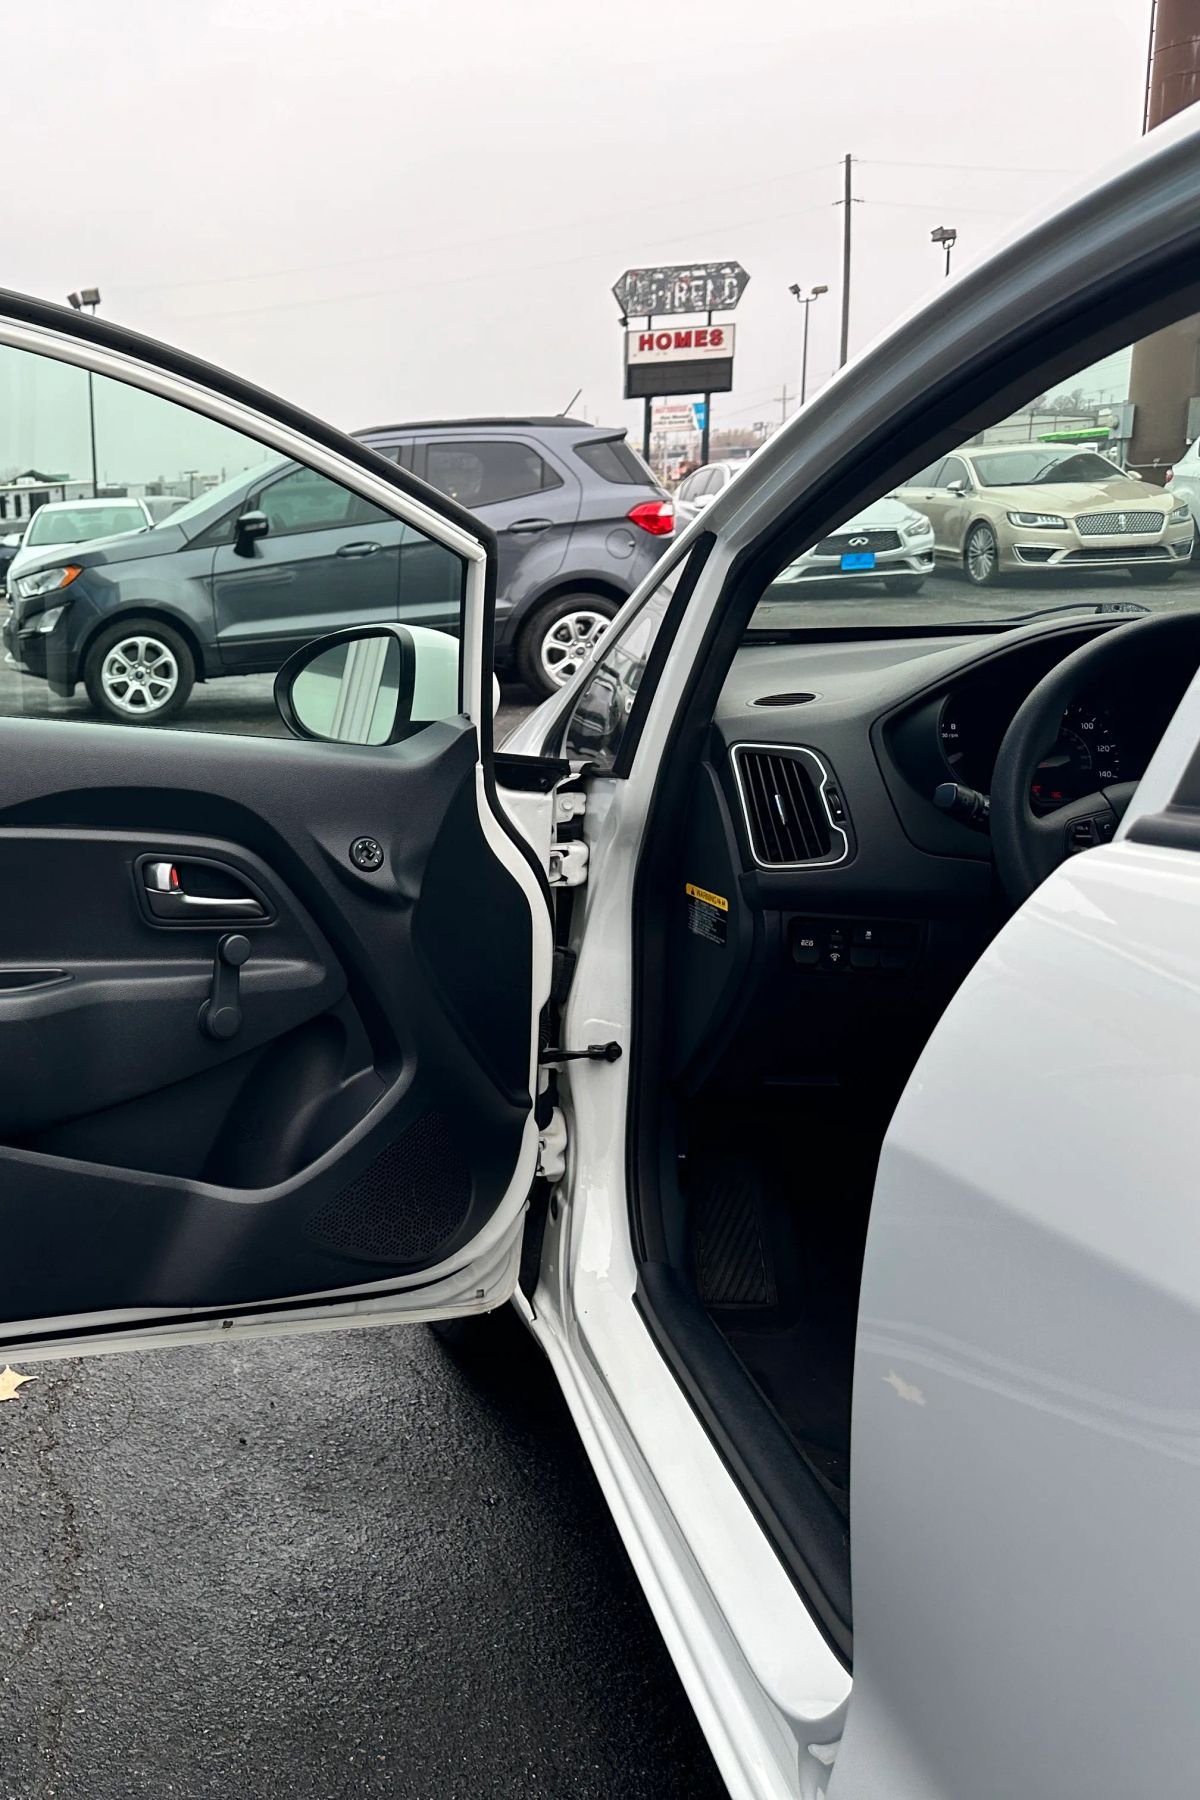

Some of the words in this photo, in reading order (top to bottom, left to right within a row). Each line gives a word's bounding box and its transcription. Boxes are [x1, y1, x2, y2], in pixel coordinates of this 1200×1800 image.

[638, 328, 724, 352] HOMES
[1081, 722, 1094, 730] 100
[1097, 745, 1110, 753] 120
[1099, 770, 1112, 779] 140
